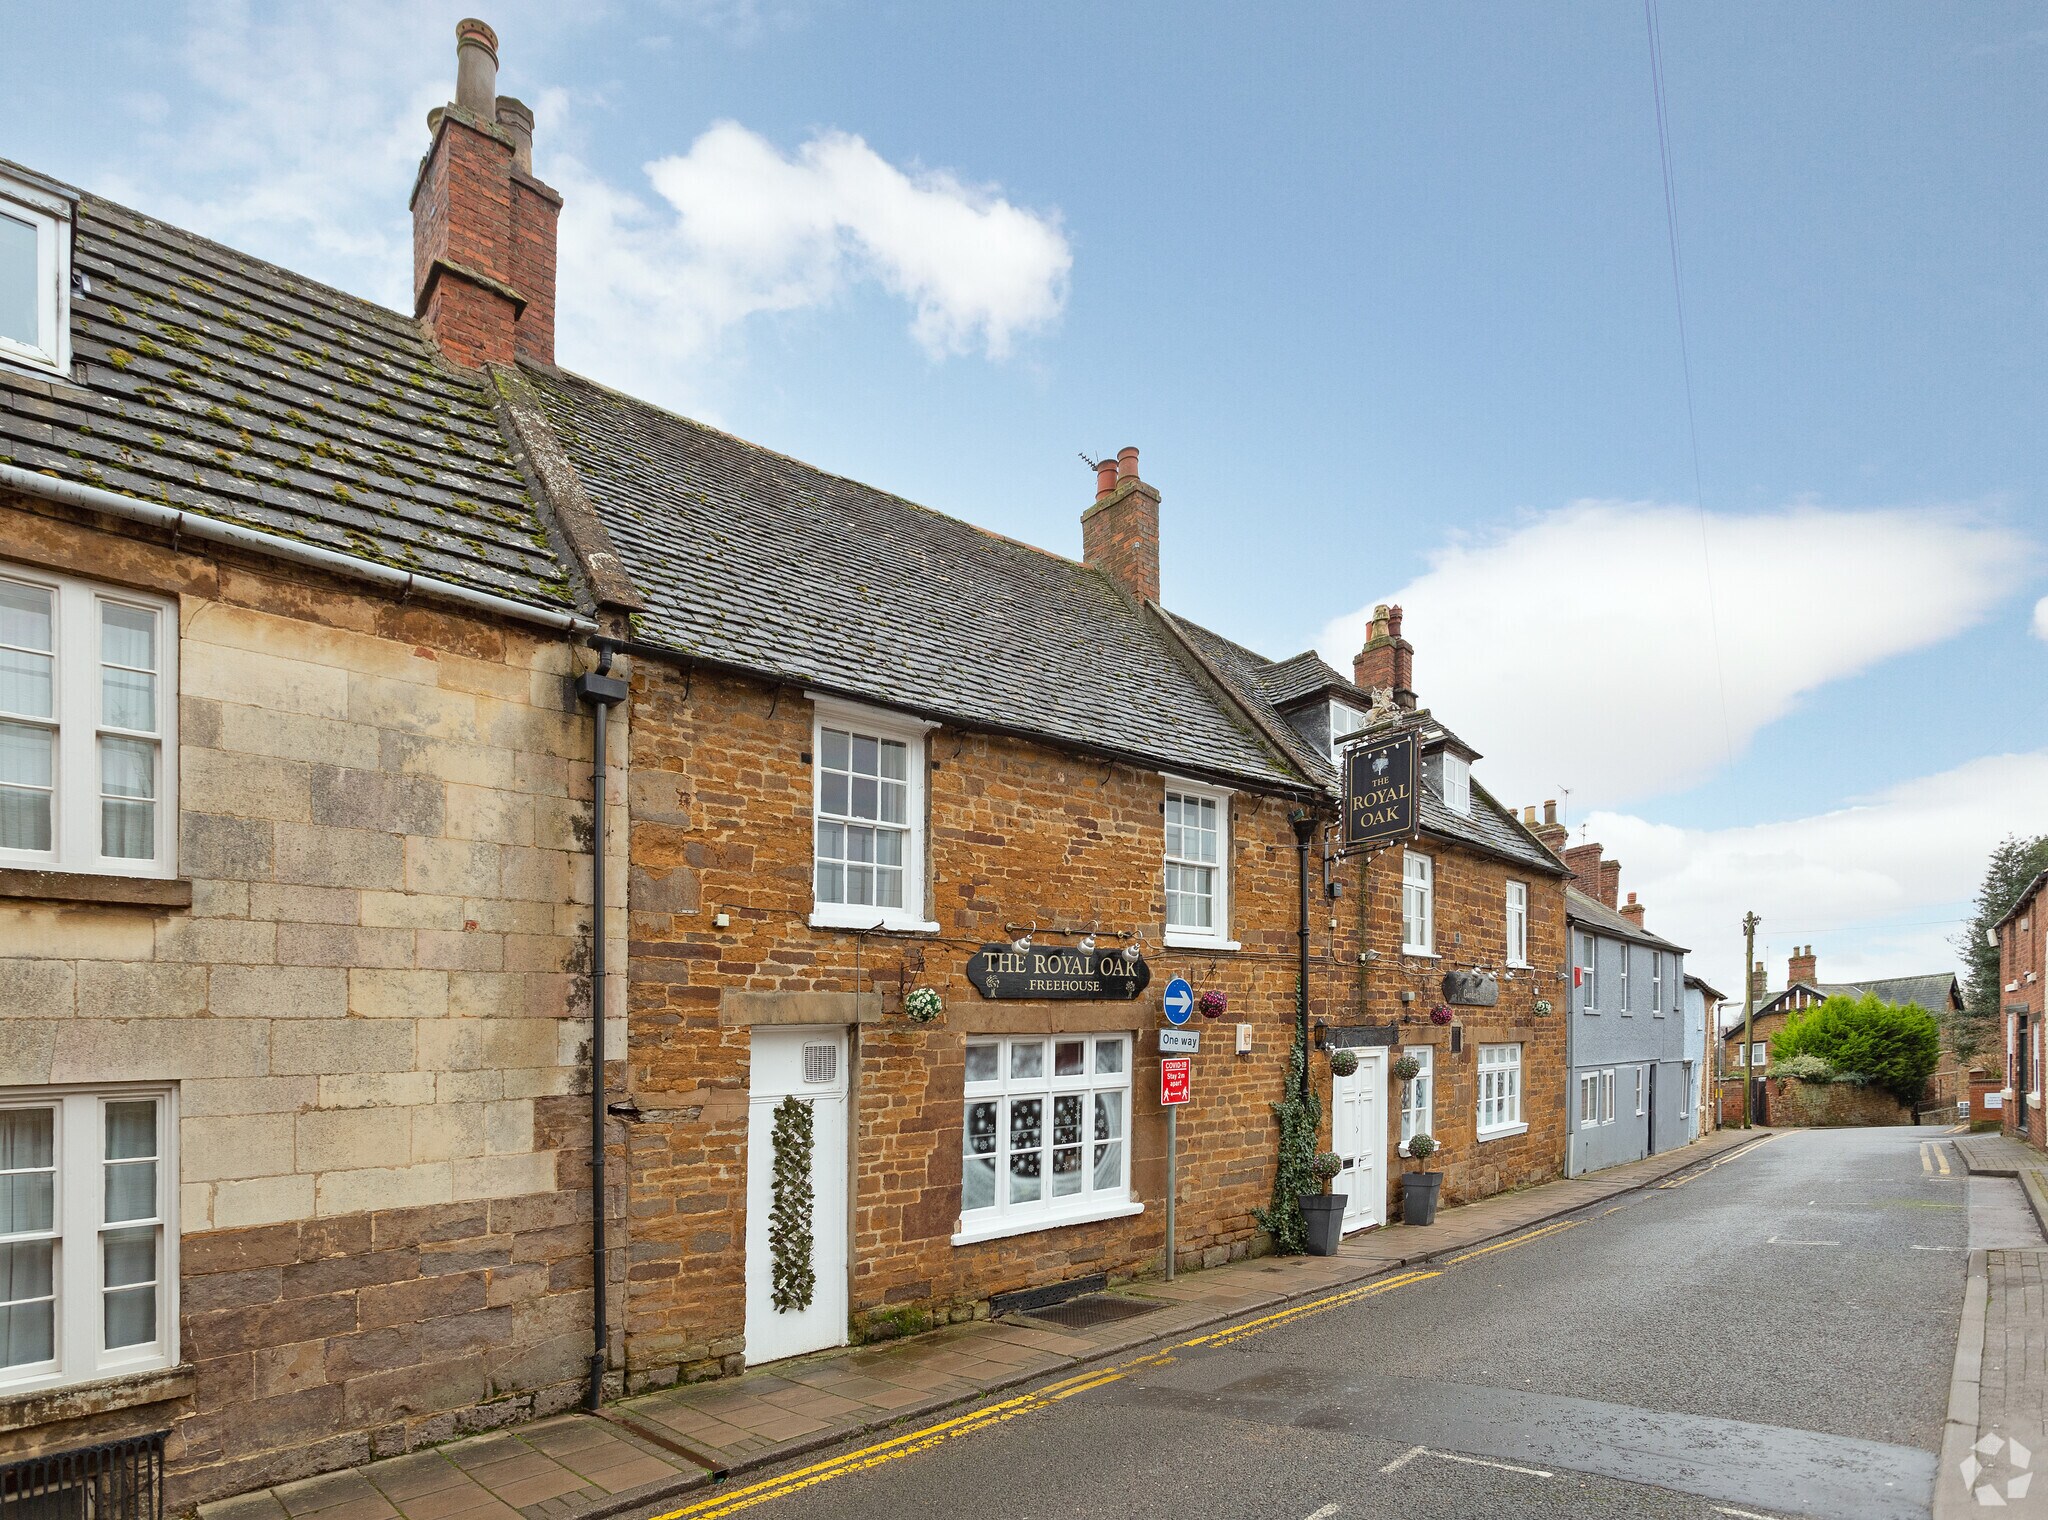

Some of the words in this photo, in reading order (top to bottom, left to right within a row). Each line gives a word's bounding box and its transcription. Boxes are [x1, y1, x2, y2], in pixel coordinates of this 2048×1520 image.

[1372, 776, 1389, 787] THE
[1353, 783, 1410, 811] ROYAL
[1360, 805, 1400, 828] OAK
[982, 952, 1027, 973] THE
[1033, 954, 1095, 975] ROYAL
[1100, 957, 1138, 977] OAK
[1163, 1034, 1179, 1045] One
[1181, 1038, 1197, 1048] way
